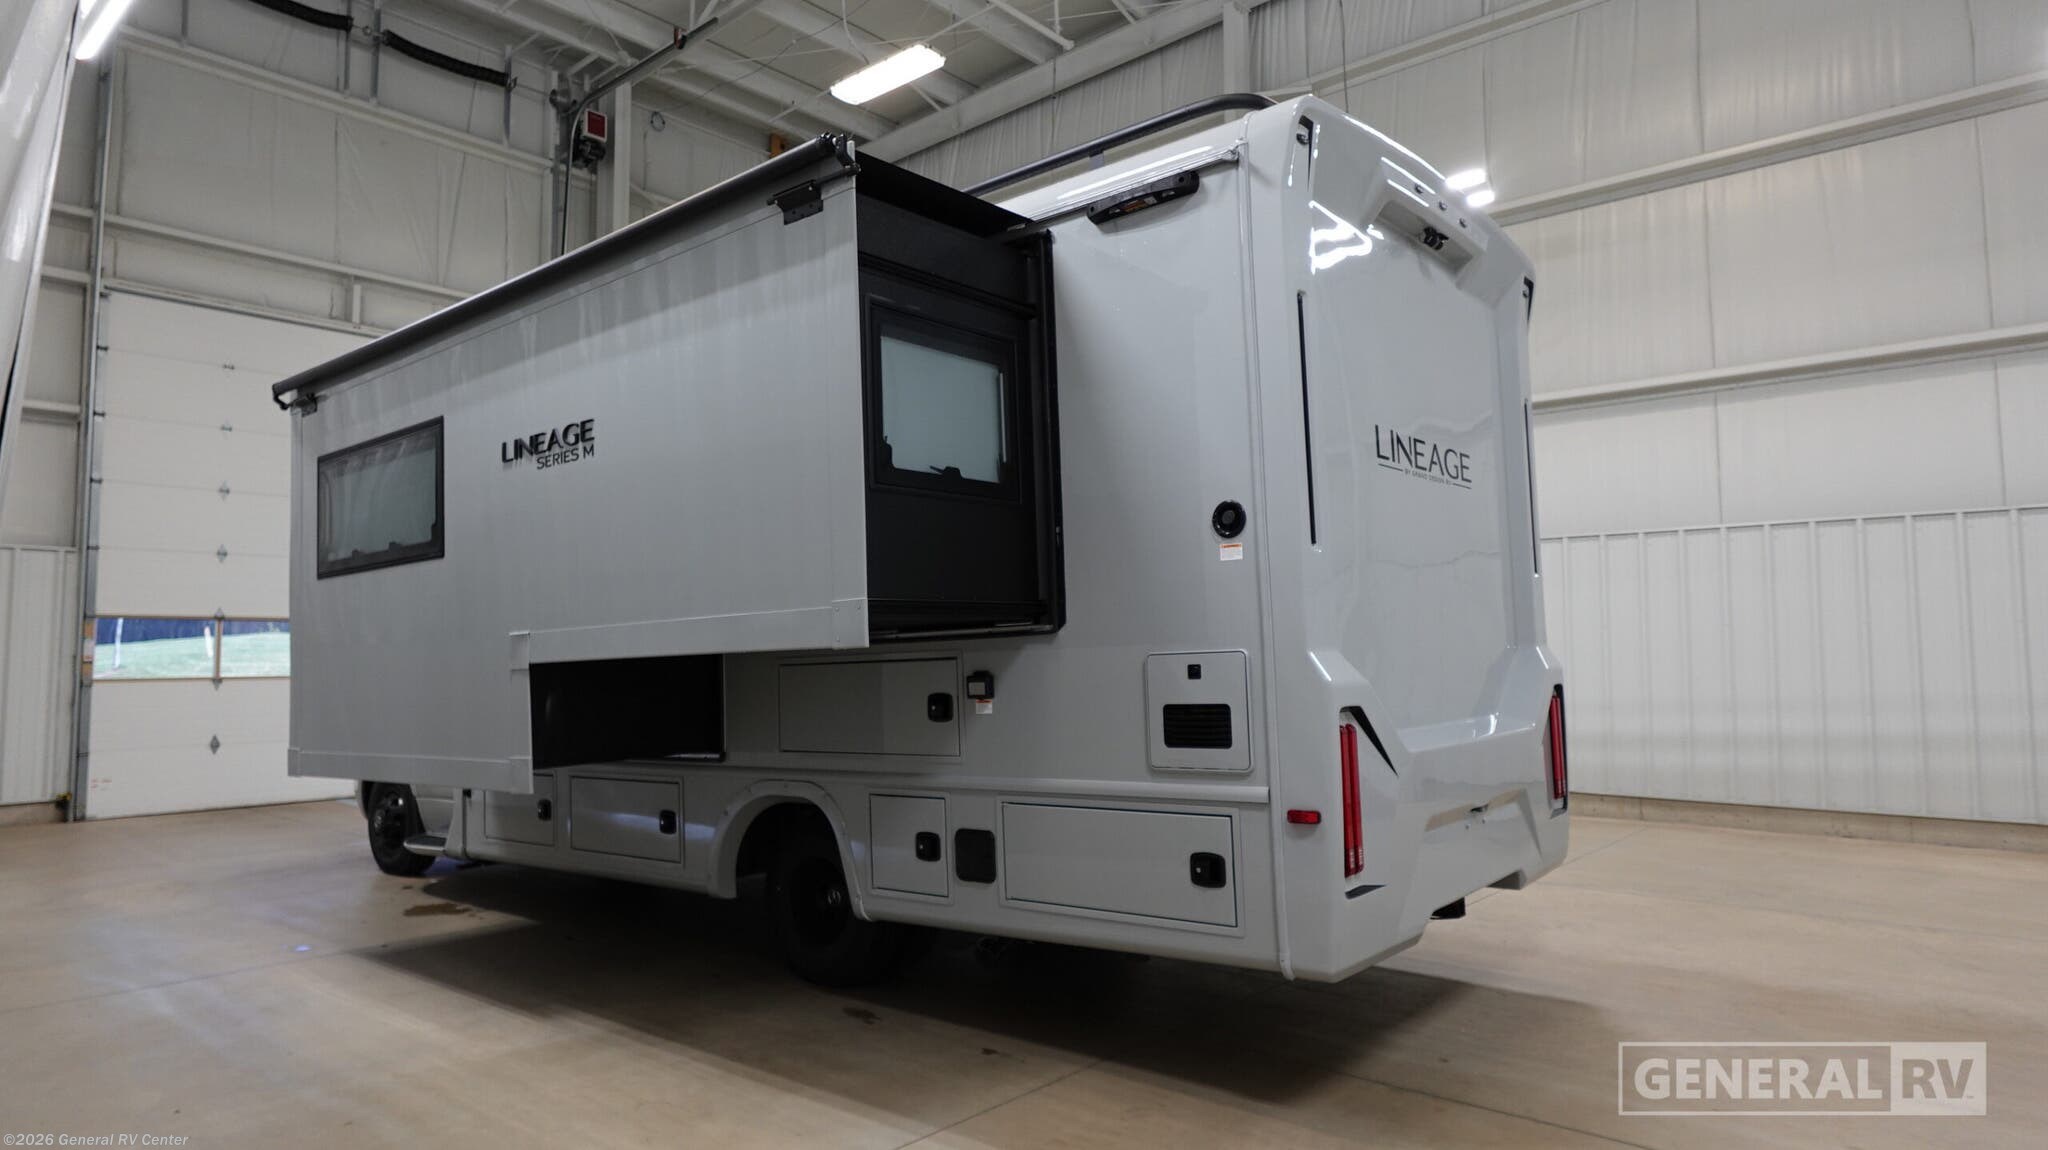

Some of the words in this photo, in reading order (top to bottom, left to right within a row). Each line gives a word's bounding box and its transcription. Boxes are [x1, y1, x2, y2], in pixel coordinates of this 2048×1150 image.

[502, 418, 595, 463] LINEAGE
[536, 447, 579, 470] SERIES
[583, 443, 595, 459] M
[1375, 424, 1472, 483] LINEAGE
